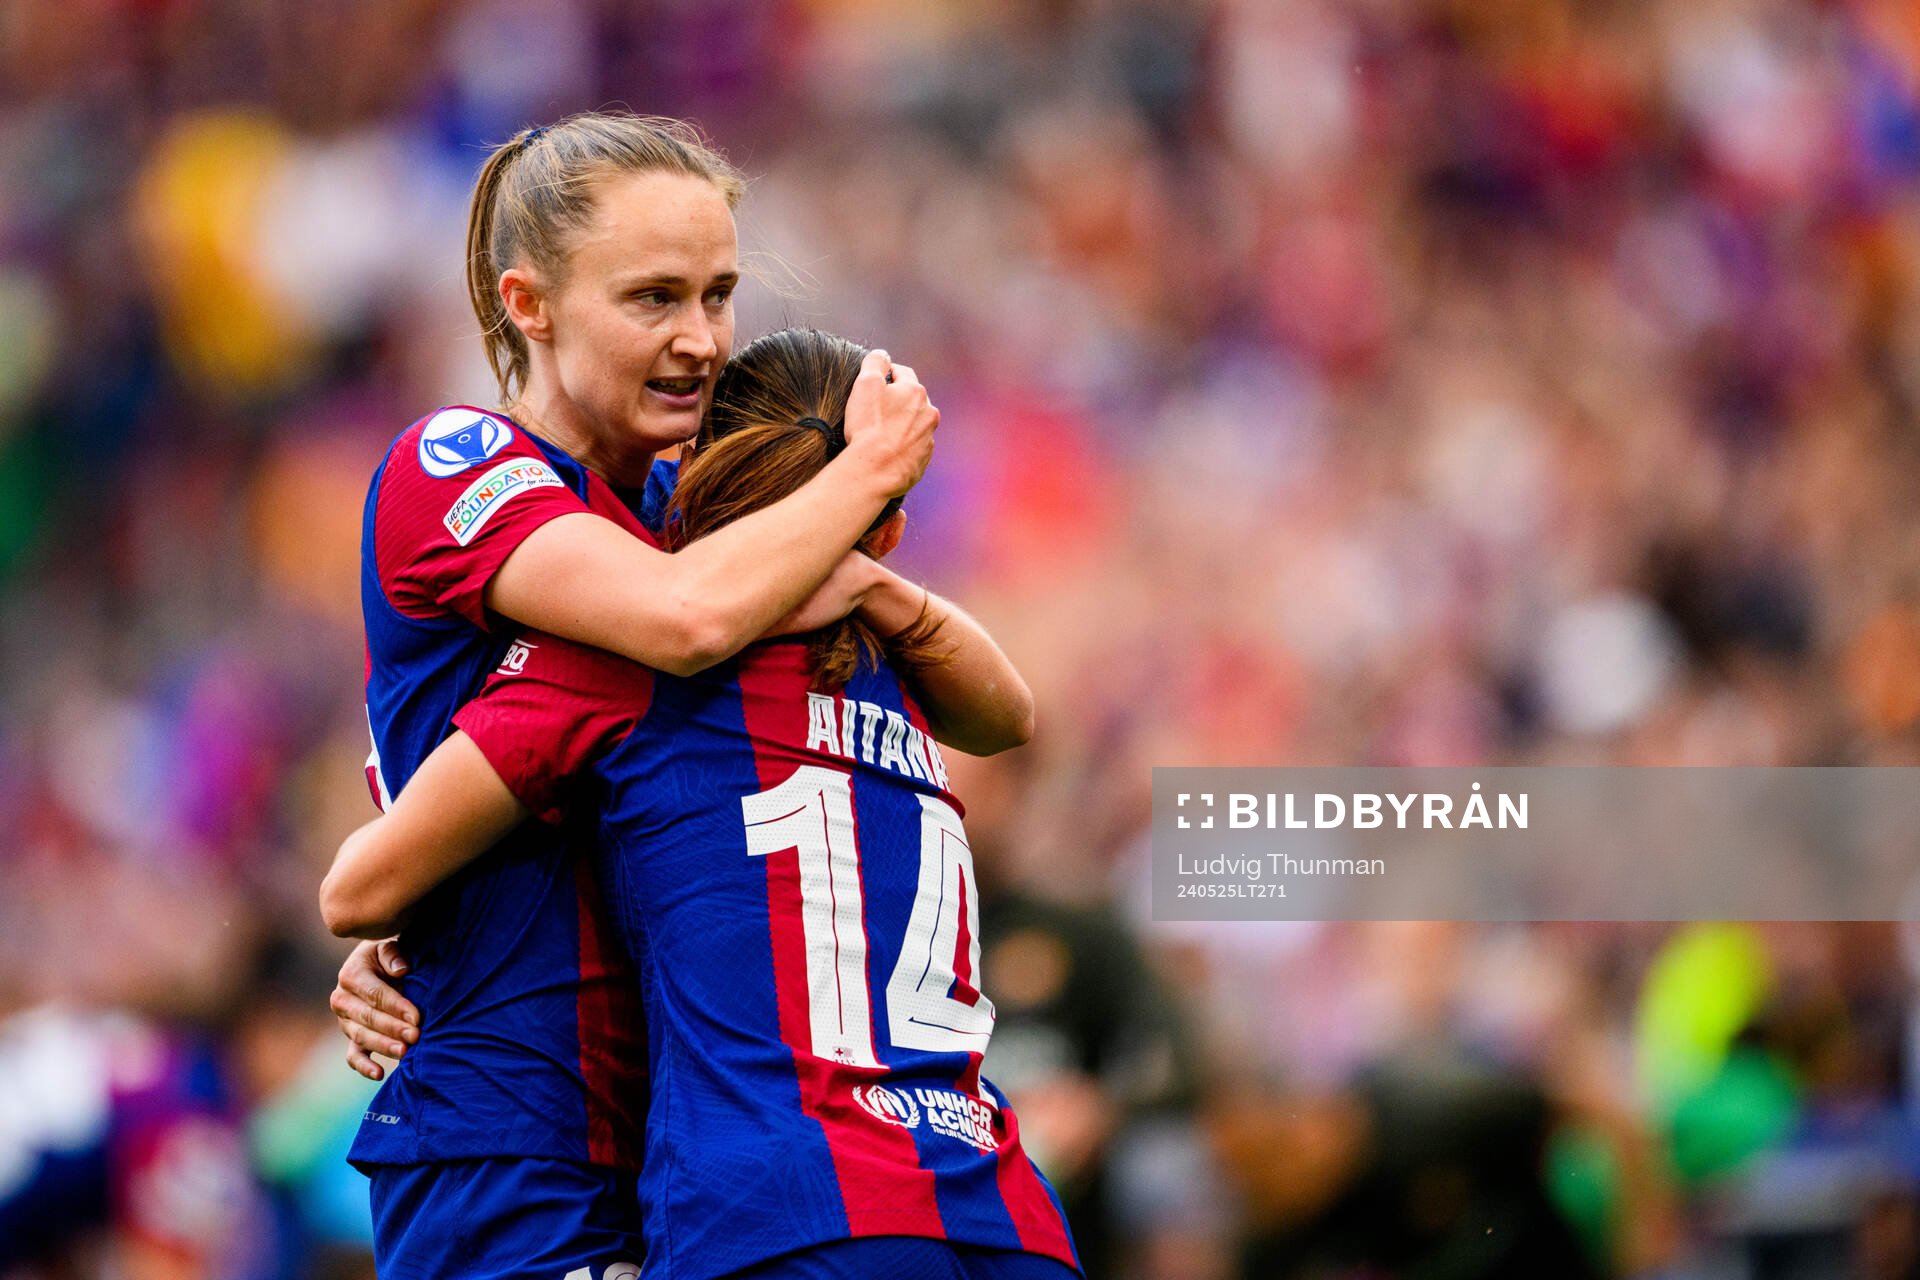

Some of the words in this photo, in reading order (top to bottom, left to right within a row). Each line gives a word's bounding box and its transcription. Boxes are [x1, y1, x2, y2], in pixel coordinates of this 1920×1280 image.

[447, 499, 467, 525] UEFA
[452, 466, 556, 534] FOUNDATION
[806, 691, 952, 793] AITANA
[741, 765, 996, 1068] 14
[915, 1088, 992, 1131] UNHCR
[927, 1108, 999, 1148] ACNUR
